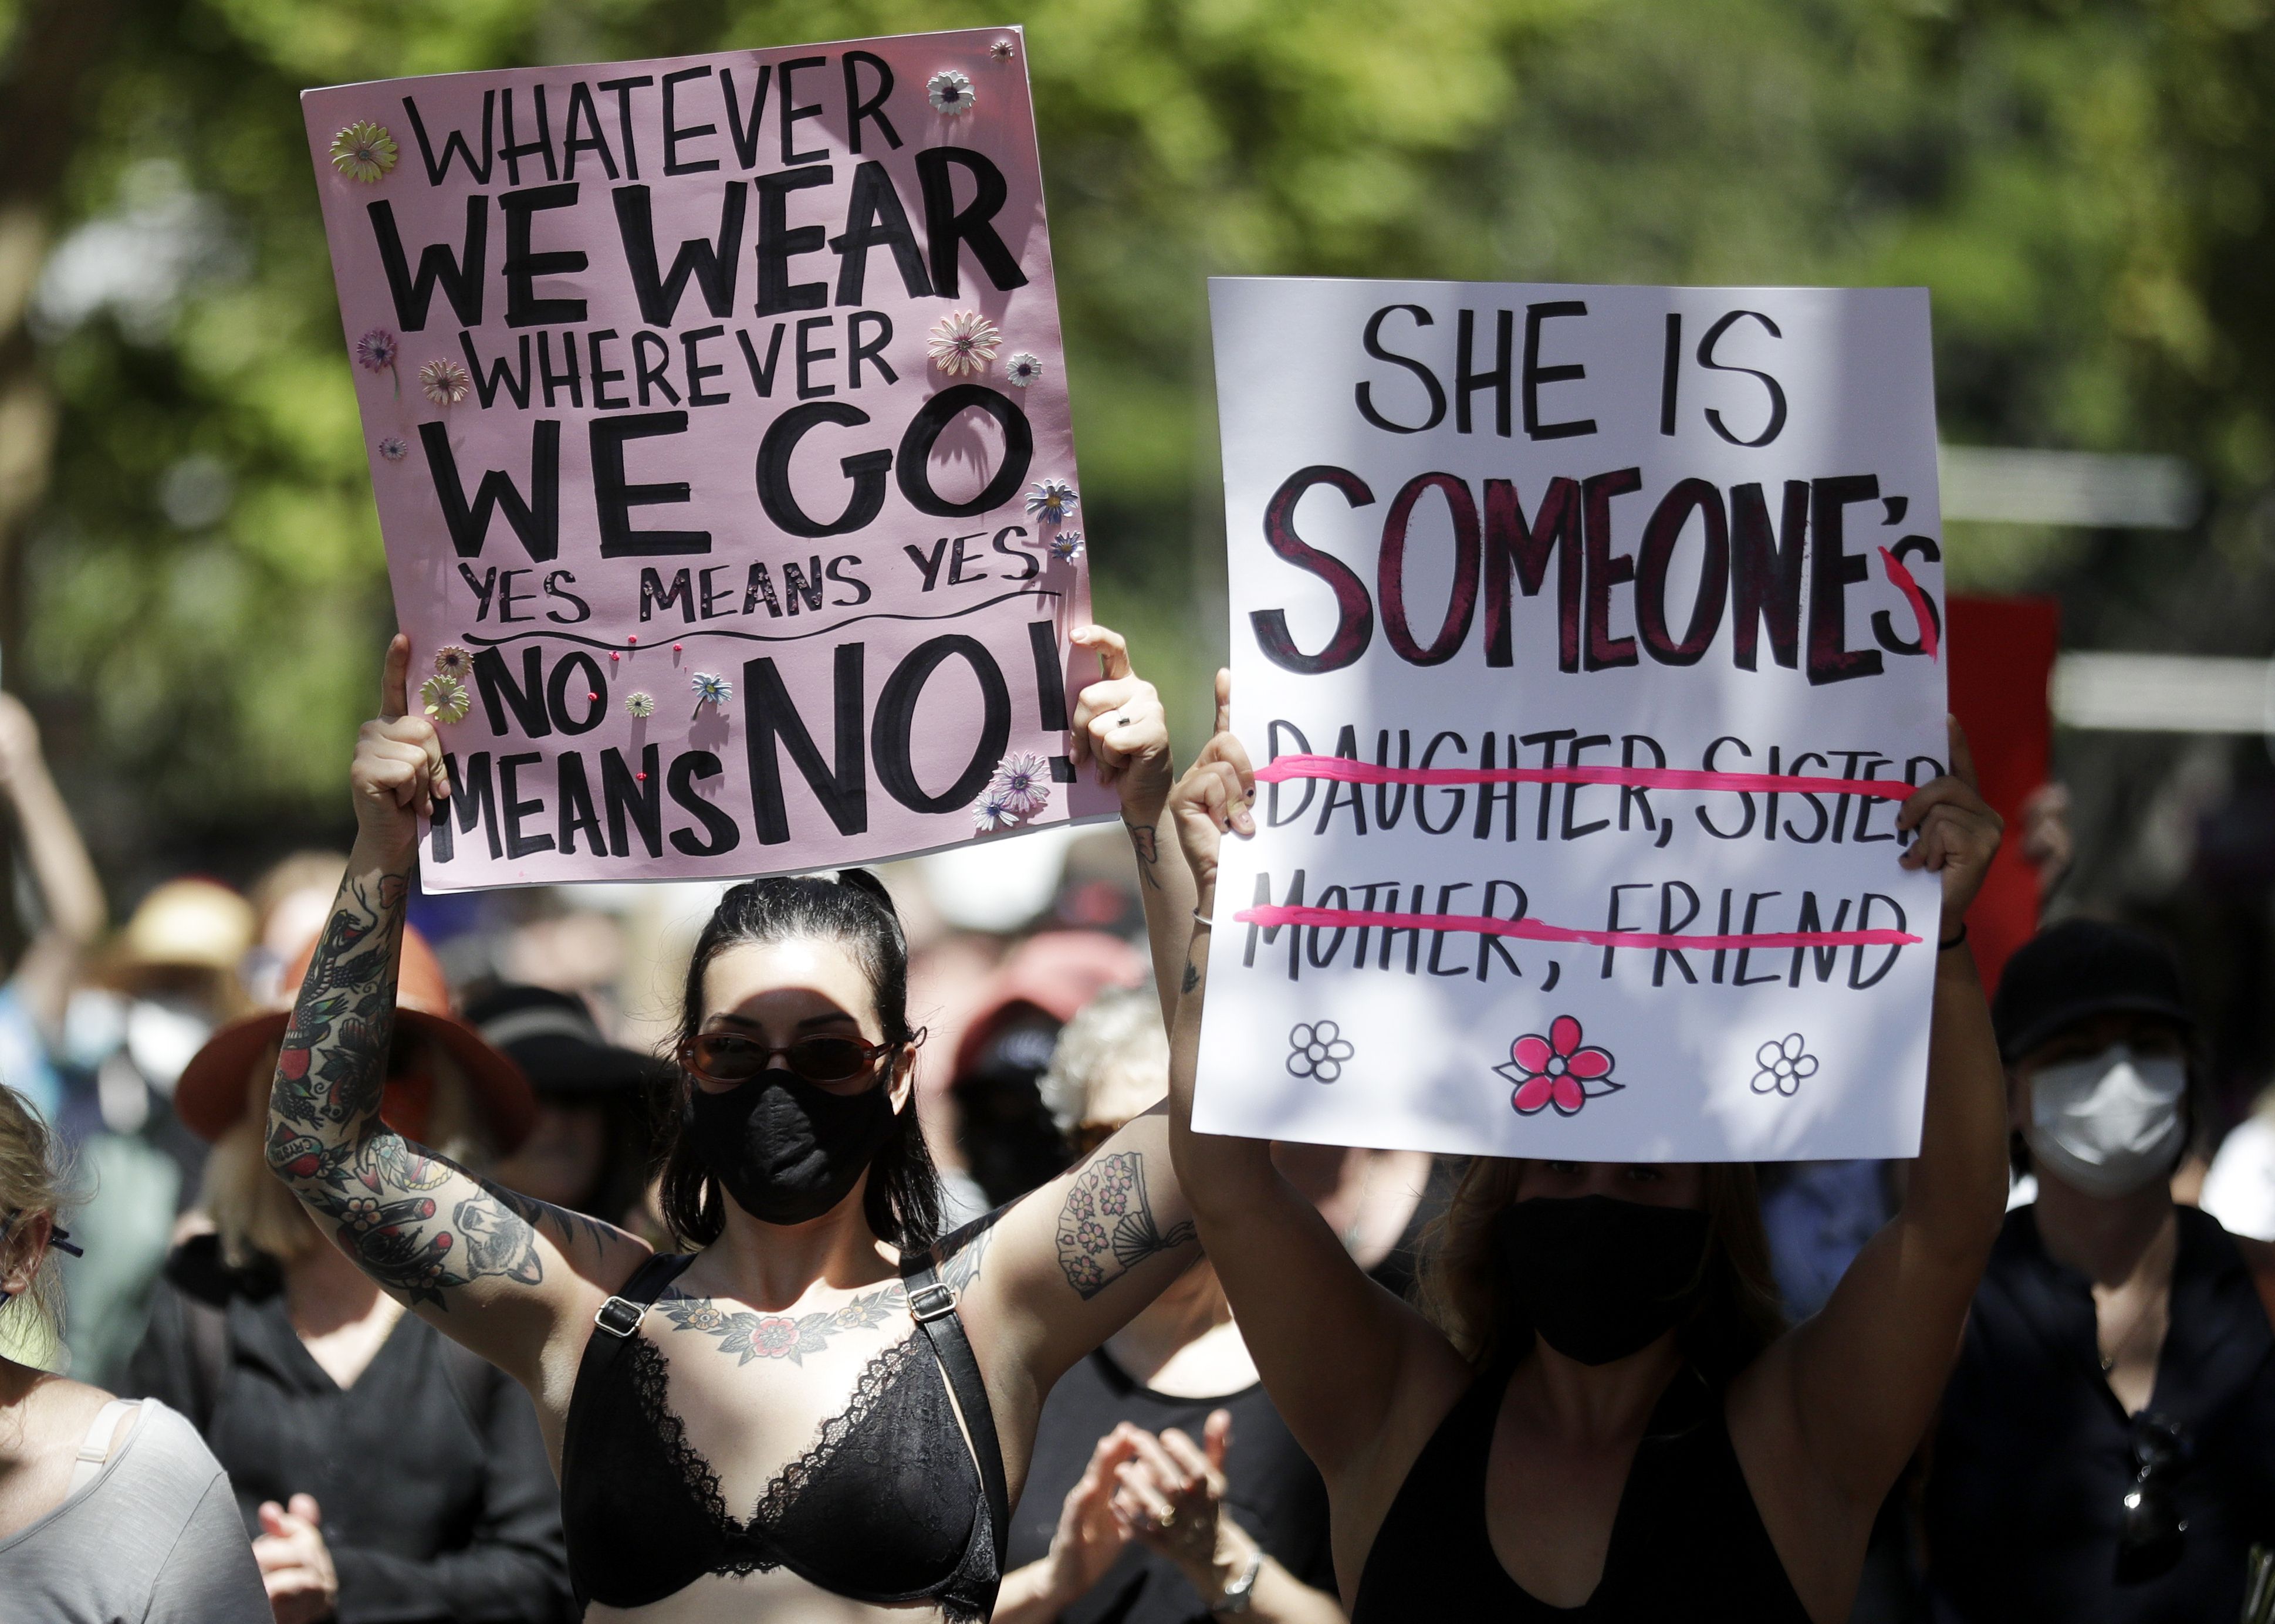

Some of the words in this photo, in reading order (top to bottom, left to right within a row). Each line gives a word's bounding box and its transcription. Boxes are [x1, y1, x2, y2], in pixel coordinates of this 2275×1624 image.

[402, 50, 904, 187] WHATEVER
[367, 182, 589, 333] WE
[611, 146, 1029, 327] WEAR
[458, 310, 900, 410] WHEREVER
[1354, 300, 1597, 441] SHE
[1660, 309, 1788, 448] IS
[418, 411, 712, 563] WE
[755, 383, 1033, 538] GO
[457, 562, 591, 624] YES
[639, 554, 871, 624] MEANS
[902, 525, 1041, 591] YES
[430, 743, 741, 864] MEANS
[742, 620, 1077, 847] NO!
[472, 645, 608, 738] NO
[1265, 719, 1674, 849] DAUGHTER,
[1243, 869, 1560, 994] MOTHER,
[1599, 880, 1908, 990] FRIEND
